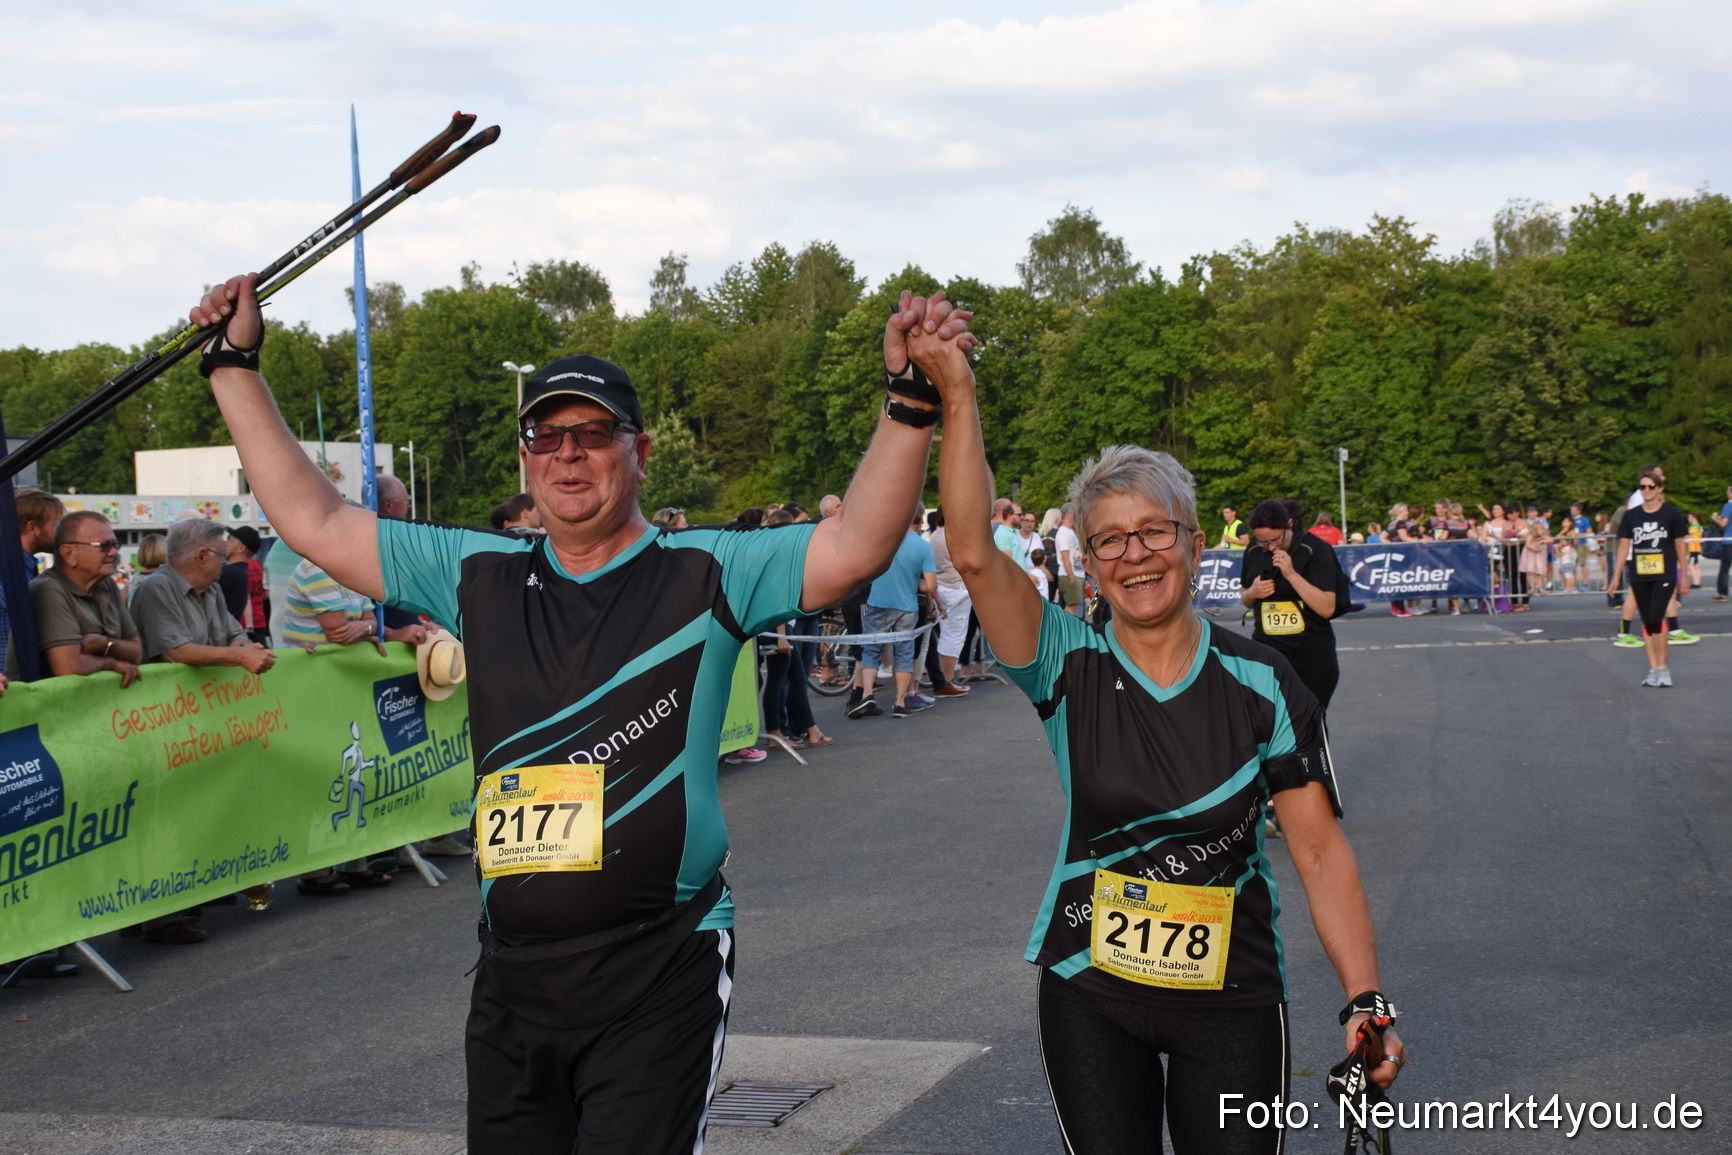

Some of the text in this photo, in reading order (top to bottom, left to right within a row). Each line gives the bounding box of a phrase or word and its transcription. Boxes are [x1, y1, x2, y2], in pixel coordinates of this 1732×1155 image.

[1369, 565, 1454, 585] Fischer
[1377, 582, 1449, 594] AUTOMOBILE
[1266, 613, 1298, 626] 1976
[112, 672, 266, 740] Gesunde Firmen
[384, 694, 419, 716] Fischer
[163, 696, 288, 770] laufen länger!
[567, 688, 679, 764] Donauer
[374, 716, 469, 800] firmenlauf
[373, 785, 425, 819] neumarkt
[492, 786, 538, 801] firmenlauf
[543, 789, 594, 802] walk 2019
[488, 802, 583, 847] 2177
[1165, 854, 1189, 876] &
[1186, 796, 1259, 862] Donauer
[491, 856, 518, 867] Siebentritt
[525, 854, 554, 862] Donauer
[498, 843, 569, 857] Donauer Dieter
[78, 836, 290, 920] www.firmenlauf-oberpfalz.de
[1112, 893, 1168, 913] firmenlauf
[1172, 910, 1223, 924] walk 2019
[1105, 911, 1210, 960] 2178
[1107, 957, 1140, 973] Siebentritt
[1149, 968, 1180, 979] Donauer
[1182, 972, 1204, 980] GmbH
[1113, 949, 1199, 971] Donauer Isabella
